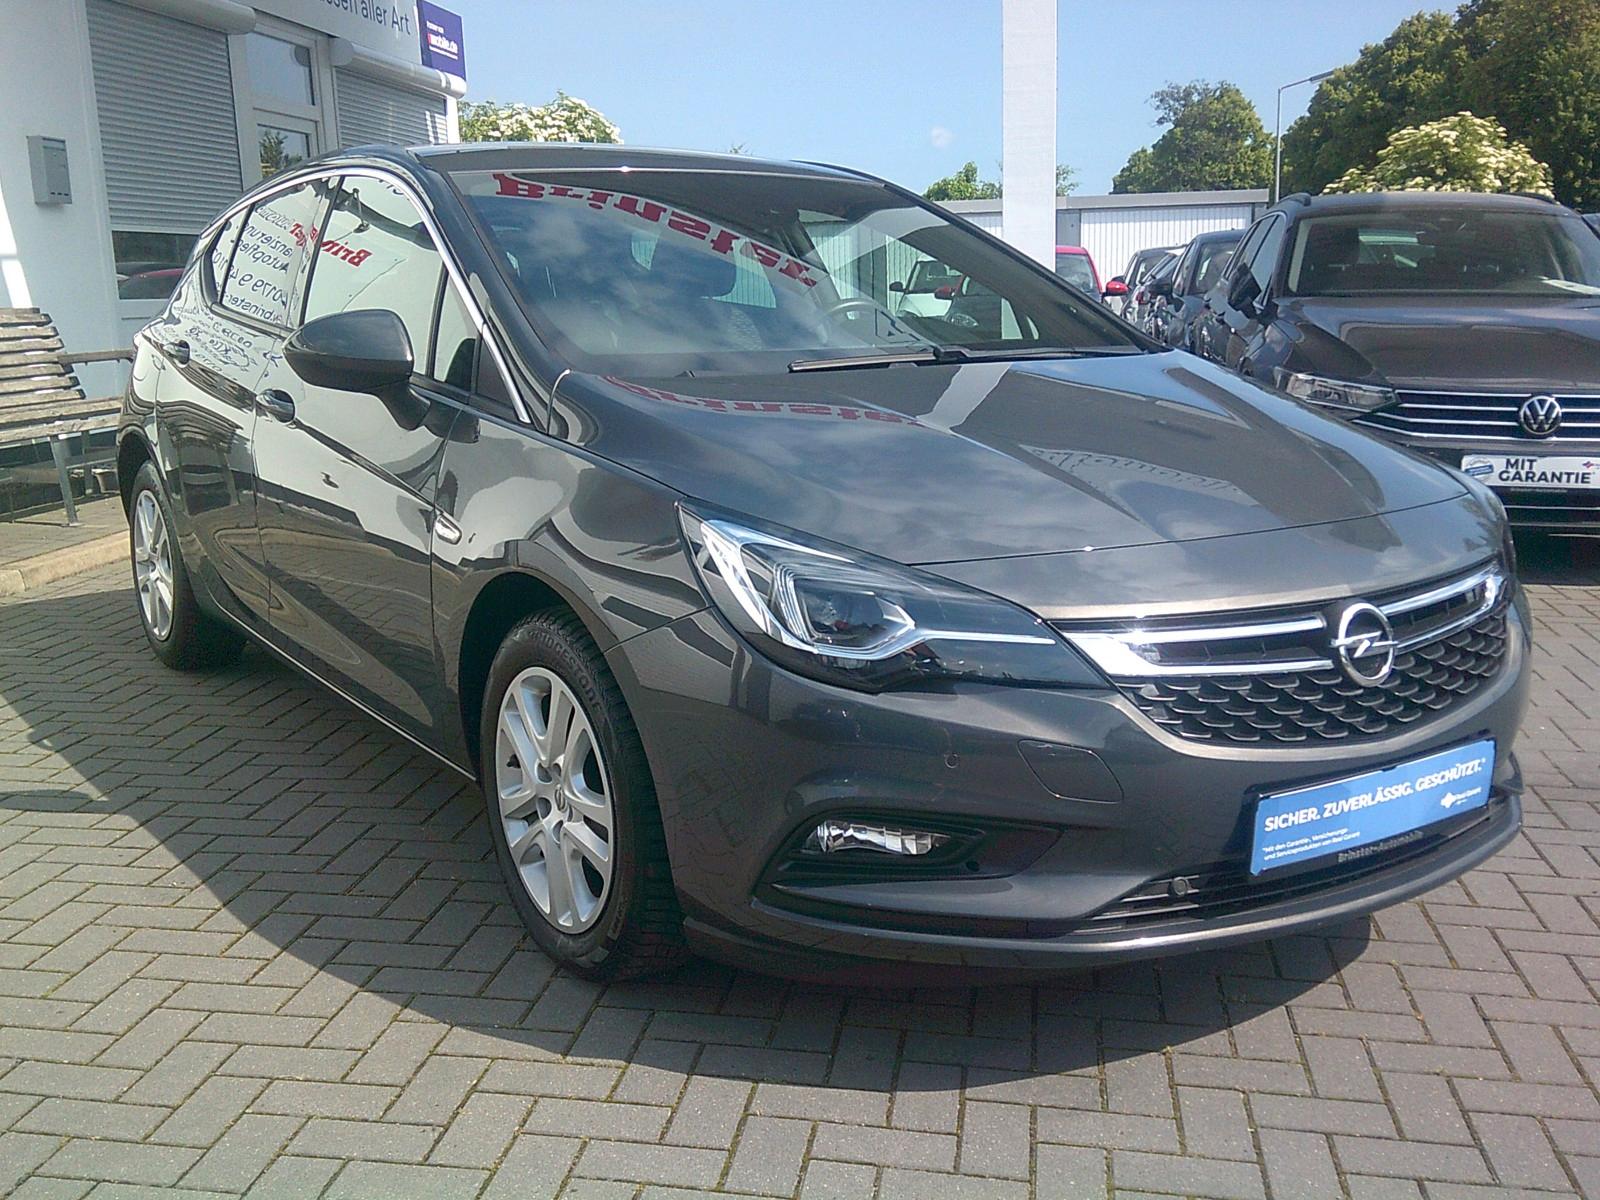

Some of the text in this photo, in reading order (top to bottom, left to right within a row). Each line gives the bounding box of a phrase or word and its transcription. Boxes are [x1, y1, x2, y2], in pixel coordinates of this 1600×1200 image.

[361, 0, 387, 25] aller
[391, 6, 411, 35] Art
[1505, 458, 1537, 471] MIT
[1264, 807, 1321, 832] SICHER.
[1322, 783, 1414, 819] ZUVERLÄSSIG.
